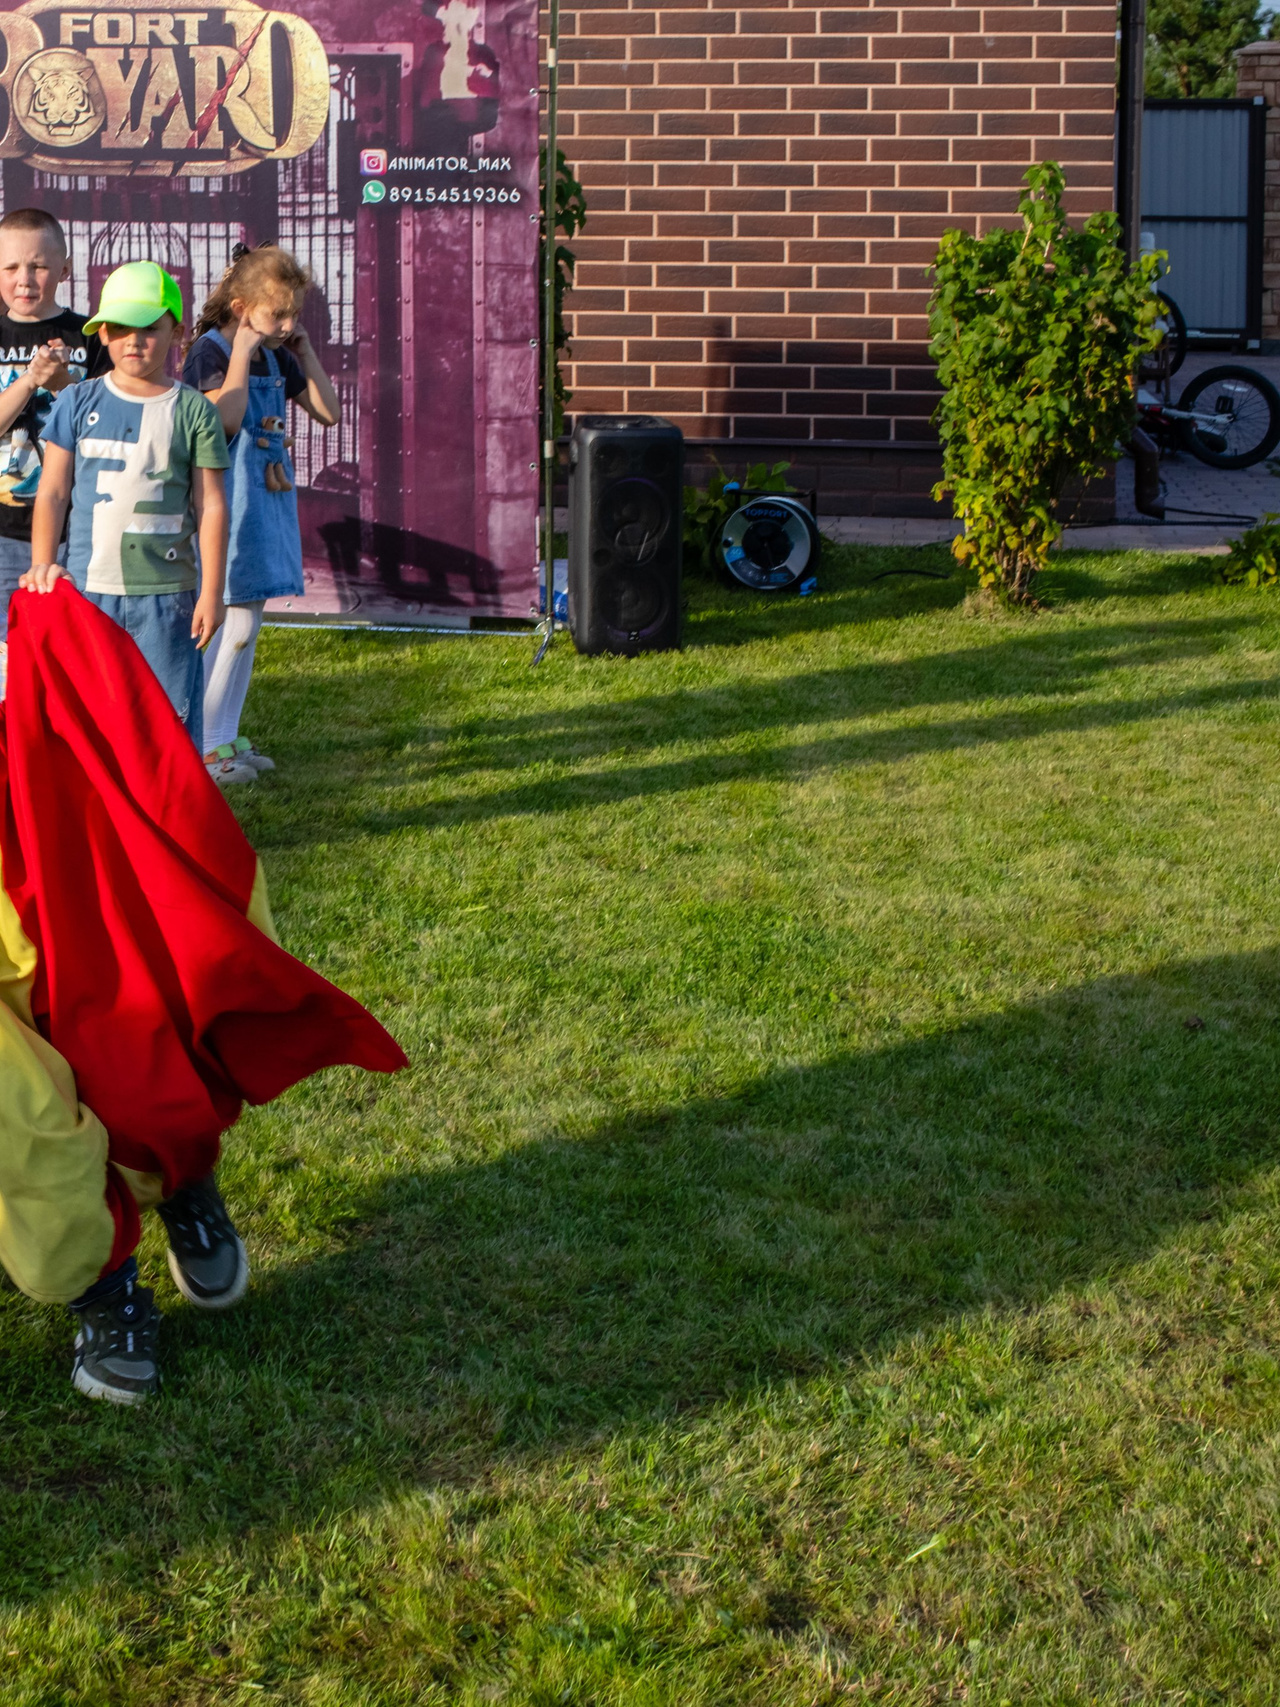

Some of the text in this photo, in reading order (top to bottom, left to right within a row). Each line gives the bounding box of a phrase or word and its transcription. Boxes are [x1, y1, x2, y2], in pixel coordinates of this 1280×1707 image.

[60, 13, 208, 45] FORT
[388, 157, 512, 173] ANIMATOR_MAX
[389, 187, 521, 203] 89154519366
